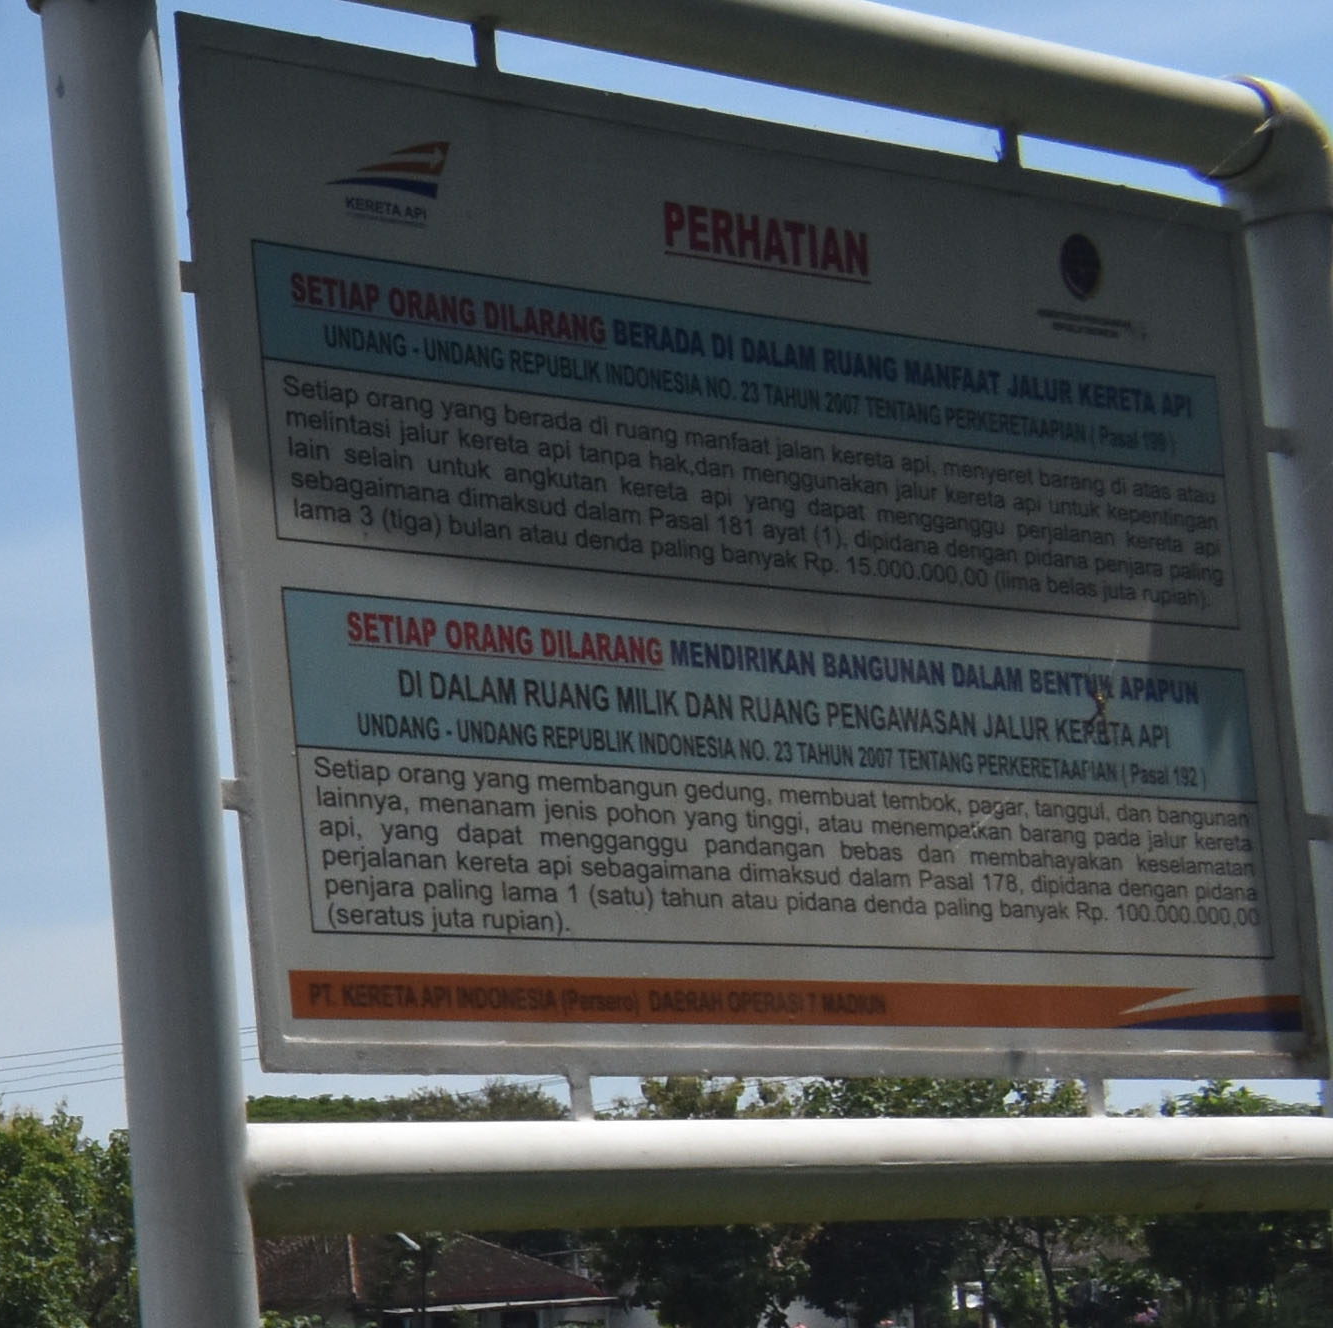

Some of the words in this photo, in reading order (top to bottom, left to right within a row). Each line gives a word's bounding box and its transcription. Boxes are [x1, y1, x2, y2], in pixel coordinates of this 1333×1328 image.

[344, 195, 402, 217] KERETA
[403, 204, 427, 220] API
[661, 200, 870, 277] PERHATIAN
[289, 274, 382, 314] SETIAP
[386, 287, 477, 326] ORANG
[482, 300, 607, 343] DILARANG
[611, 318, 705, 357] BERADA
[710, 332, 735, 361] DI
[739, 336, 817, 371] DALAM
[822, 347, 899, 382] RUANG
[903, 358, 1002, 396] MANFAAT
[1004, 372, 1073, 405] JALUR
[1077, 382, 1156, 416] KERETA
[1159, 393, 1193, 421] API
[323, 325, 408, 359] UNDANG
[422, 338, 505, 371] UNDANG
[508, 349, 601, 383] REPUBLIK
[604, 362, 702, 396] INDONESIA
[740, 380, 760, 403] 23
[761, 382, 821, 411] TAHUN
[282, 378, 360, 411] Setiap
[365, 391, 435, 420] orang
[440, 400, 498, 427] yang
[502, 404, 583, 433] berada
[587, 414, 609, 436] di
[614, 421, 679, 449] ruang
[683, 426, 770, 454] manfaat
[284, 408, 392, 440] melintasi
[398, 421, 451, 451] jalur
[457, 427, 530, 455] kereta
[535, 436, 572, 464] api
[578, 442, 642, 472] tanpa
[287, 438, 331, 463] lain
[343, 444, 414, 471] selain
[426, 453, 491, 480] untuk
[502, 462, 608, 499] angkutan
[619, 475, 688, 500] kereta
[699, 484, 733, 512] api
[289, 469, 451, 511] sebagaimana
[456, 486, 567, 517] dimaksud
[572, 498, 642, 525] dalam
[647, 506, 709, 532] Pasal
[292, 498, 352, 525] lama
[359, 505, 375, 527] 3
[380, 507, 443, 540] (tiga)
[447, 514, 512, 540] bulan
[517, 522, 568, 545] atau
[573, 528, 644, 553] denda
[649, 535, 716, 565] paling
[720, 542, 798, 573] banyak
[345, 612, 438, 647] SETIAP
[444, 620, 534, 655] ORANG
[539, 628, 663, 664] DILARANG
[669, 639, 816, 676] MENDIRIKAN
[821, 652, 946, 686] BANGUNAN
[950, 662, 1023, 692] DALAM
[1117, 675, 1199, 705] APAPUN
[397, 670, 423, 699] DI
[428, 672, 518, 705] DALAM
[522, 679, 610, 712] RUANG
[615, 686, 678, 716] MILIK
[684, 691, 734, 720] DAN
[739, 695, 820, 726] RUANG
[825, 701, 977, 736] PENGAWASAN
[981, 712, 1050, 741] JALUR
[1135, 723, 1170, 749] API
[356, 713, 441, 741] UNDANG
[456, 719, 538, 747] UNDANG
[541, 724, 634, 752] REPUBLIK
[637, 731, 736, 759] INDONESIA
[737, 738, 769, 761] NO.
[773, 740, 793, 763] 23
[797, 742, 854, 766] TAHUN
[857, 746, 894, 769] 2007
[897, 748, 974, 773] TENTANG
[1129, 763, 1169, 785] Pasal
[1173, 765, 1198, 787] 192
[313, 758, 392, 787] Setiap
[396, 767, 467, 791] orang
[472, 771, 531, 795] yang
[536, 771, 678, 802] membangun
[682, 779, 773, 807] gedung,
[778, 784, 876, 808] membuat
[881, 790, 963, 817] tembok,
[1034, 799, 1111, 825] tanggul,
[1115, 803, 1151, 823] dan
[1156, 805, 1251, 832] bangunan
[315, 787, 409, 817] lainnya,
[418, 796, 536, 818] menanam
[544, 799, 598, 826] jenis
[605, 802, 677, 829] pohon
[683, 810, 738, 832] yang
[744, 810, 812, 836] tinggi,
[816, 813, 863, 833] atau
[1019, 824, 1087, 849] barang
[1093, 827, 1142, 851] pada
[1147, 830, 1188, 853] jalur
[1193, 832, 1254, 852] kereta
[317, 816, 362, 843] api,
[380, 823, 440, 846] yang
[455, 822, 524, 850] dapat
[539, 830, 689, 857] mengganggu
[703, 834, 825, 863] pandangan
[839, 840, 904, 861] bebas
[916, 843, 955, 864] dan
[968, 846, 1123, 875] membahayakan
[1135, 854, 1256, 877] keselamatan
[320, 845, 448, 875] perjalanan
[455, 850, 529, 873] kereta
[536, 854, 573, 879] api
[579, 856, 732, 885] sebagaimana
[738, 862, 841, 885] dimaksud
[847, 867, 911, 888] dalam
[918, 870, 974, 890] Pasal
[980, 872, 1023, 896] 178,
[1029, 874, 1113, 900] dipidana
[1117, 878, 1189, 902] dengan
[1194, 881, 1259, 905] pidana
[323, 874, 415, 903] penjara
[422, 878, 494, 906] paling
[500, 880, 558, 902] lama
[567, 883, 578, 903] 1
[587, 884, 655, 911] (satu)
[660, 887, 724, 908] tahun
[730, 889, 778, 910] atau
[785, 891, 858, 917] pidana
[862, 894, 927, 915] denda
[933, 897, 994, 921] paling
[998, 899, 1069, 924] banyak
[1075, 902, 1108, 925] Rp.
[1115, 903, 1262, 930] 100.000.000,00
[326, 904, 425, 933] (seratus
[431, 907, 475, 934] juta
